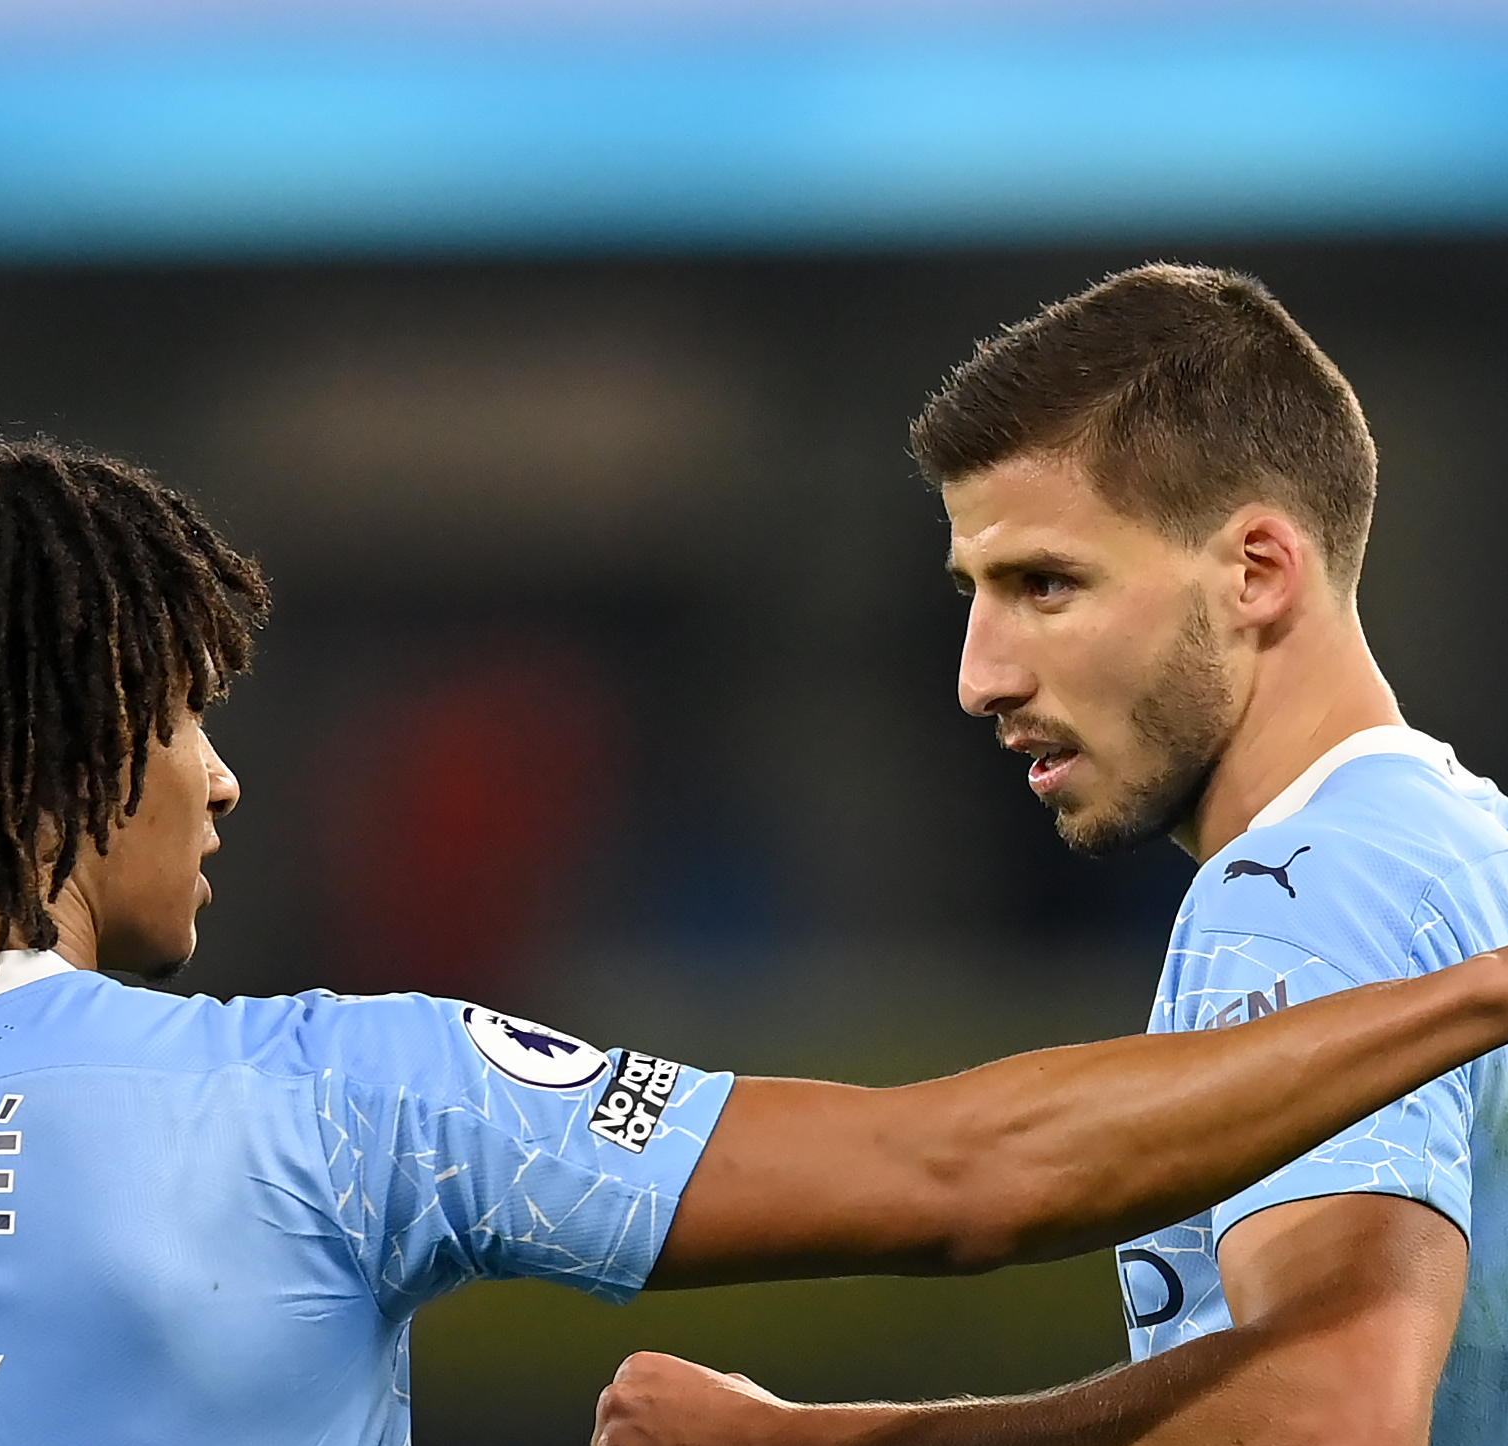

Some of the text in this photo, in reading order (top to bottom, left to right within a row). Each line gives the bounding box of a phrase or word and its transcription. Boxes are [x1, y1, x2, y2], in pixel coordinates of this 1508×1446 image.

[1205, 979, 1288, 1031] EN
[589, 1091, 633, 1142] No
[615, 1102, 657, 1153] for
[1119, 1248, 1184, 1329] D
